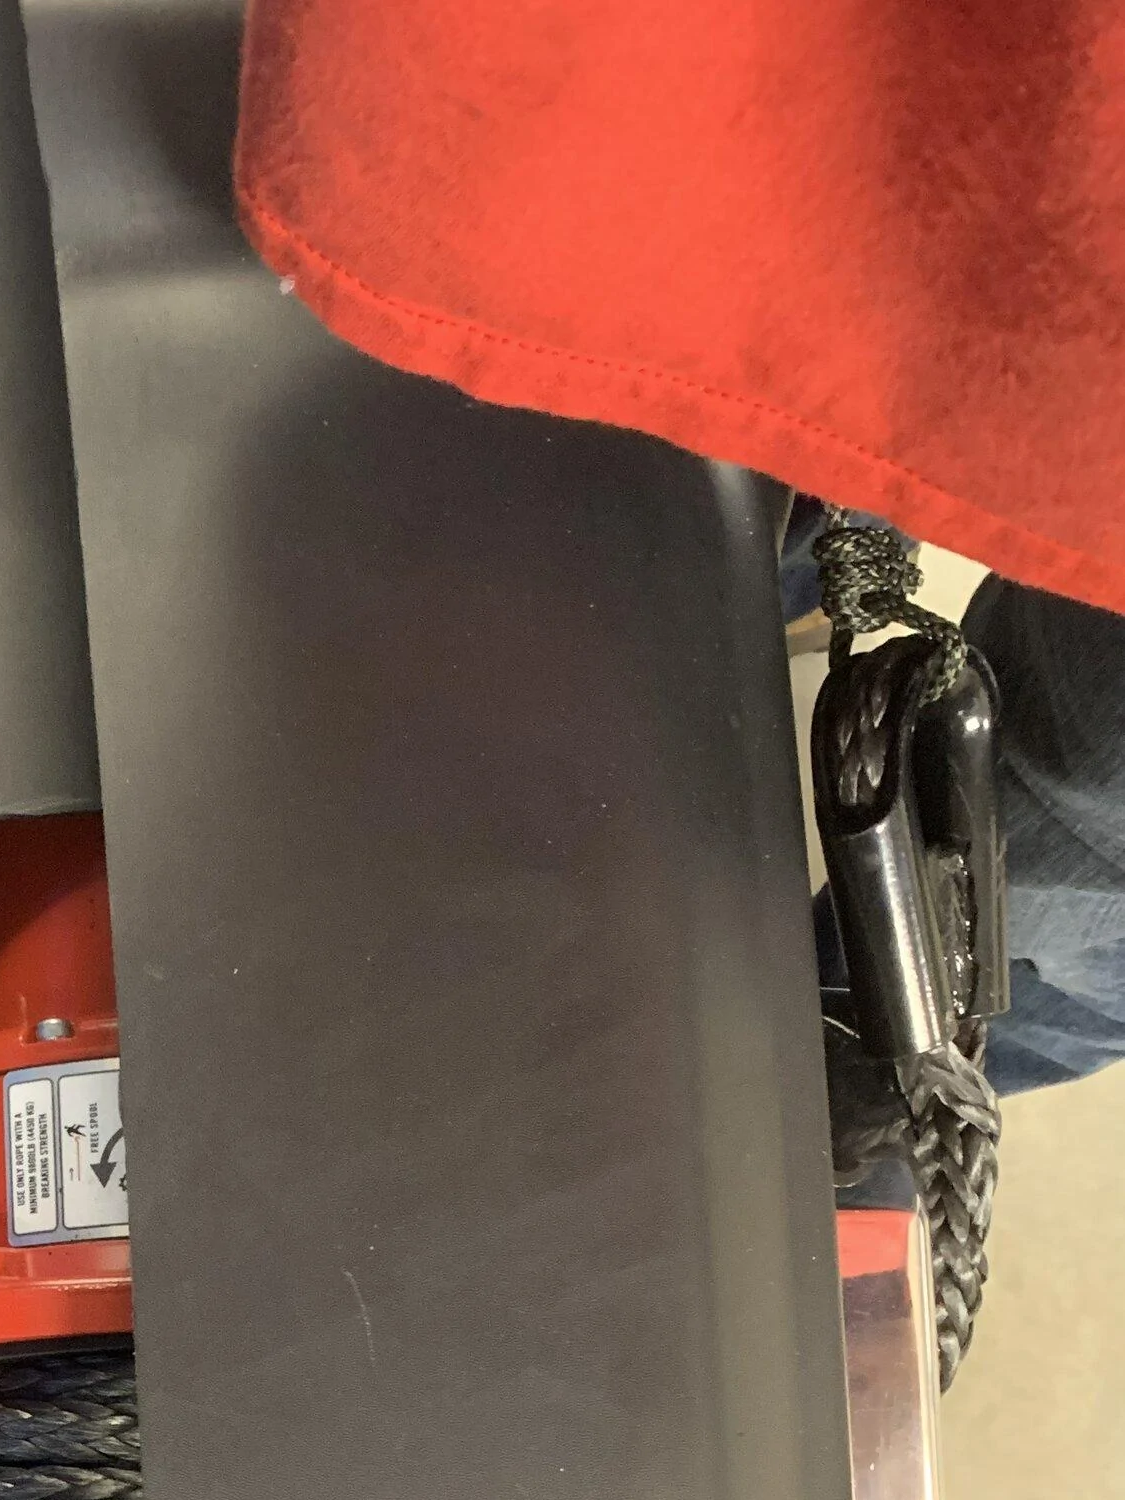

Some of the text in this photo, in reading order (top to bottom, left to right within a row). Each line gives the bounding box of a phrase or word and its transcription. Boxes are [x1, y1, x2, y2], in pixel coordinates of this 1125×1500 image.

[26, 1101, 34, 1115] KG)
[15, 1121, 23, 1141] WITH
[90, 1102, 99, 1153] FREE SPOOL
[16, 1145, 24, 1165] ROPE
[39, 1114, 49, 1198] BREAKING STRENGTH
[16, 1169, 25, 1188] ONLY
[17, 1191, 26, 1206] USE
[29, 1176, 37, 1214] MINIMUM
